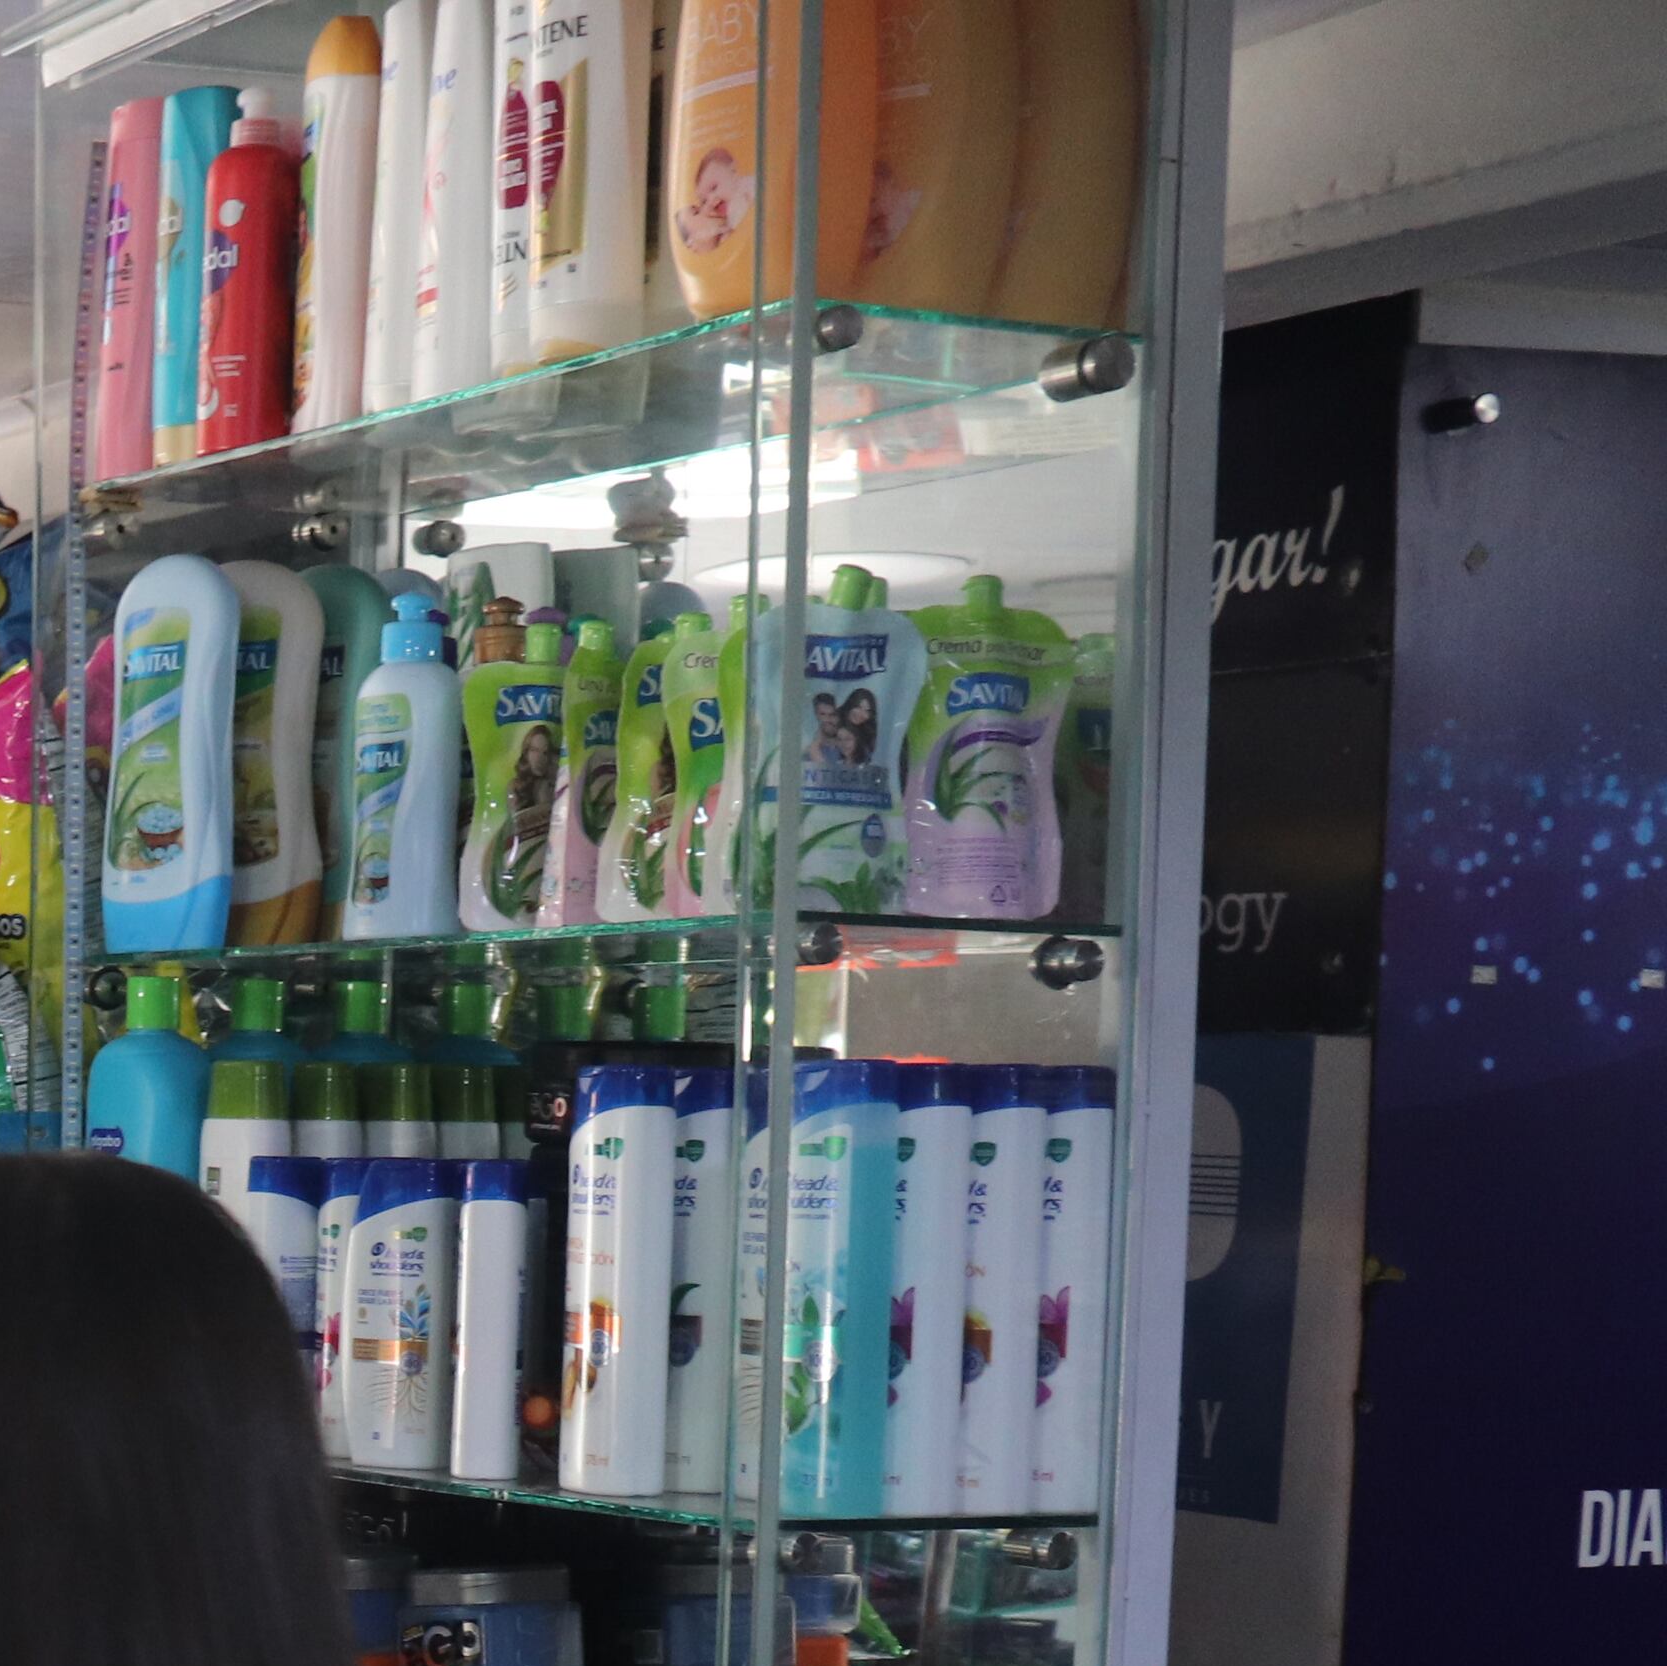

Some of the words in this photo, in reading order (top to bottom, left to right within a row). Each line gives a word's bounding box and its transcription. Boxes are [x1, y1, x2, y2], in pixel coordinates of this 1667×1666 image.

[535, 15, 589, 50] TENE
[203, 244, 239, 272] dal
[1211, 484, 1345, 626] gar!
[807, 648, 886, 675] AVITAL
[927, 637, 981, 657] Crema
[497, 685, 562, 719] SAVI
[1199, 891, 1288, 952] ogy
[1577, 1488, 1667, 1569] DIA
